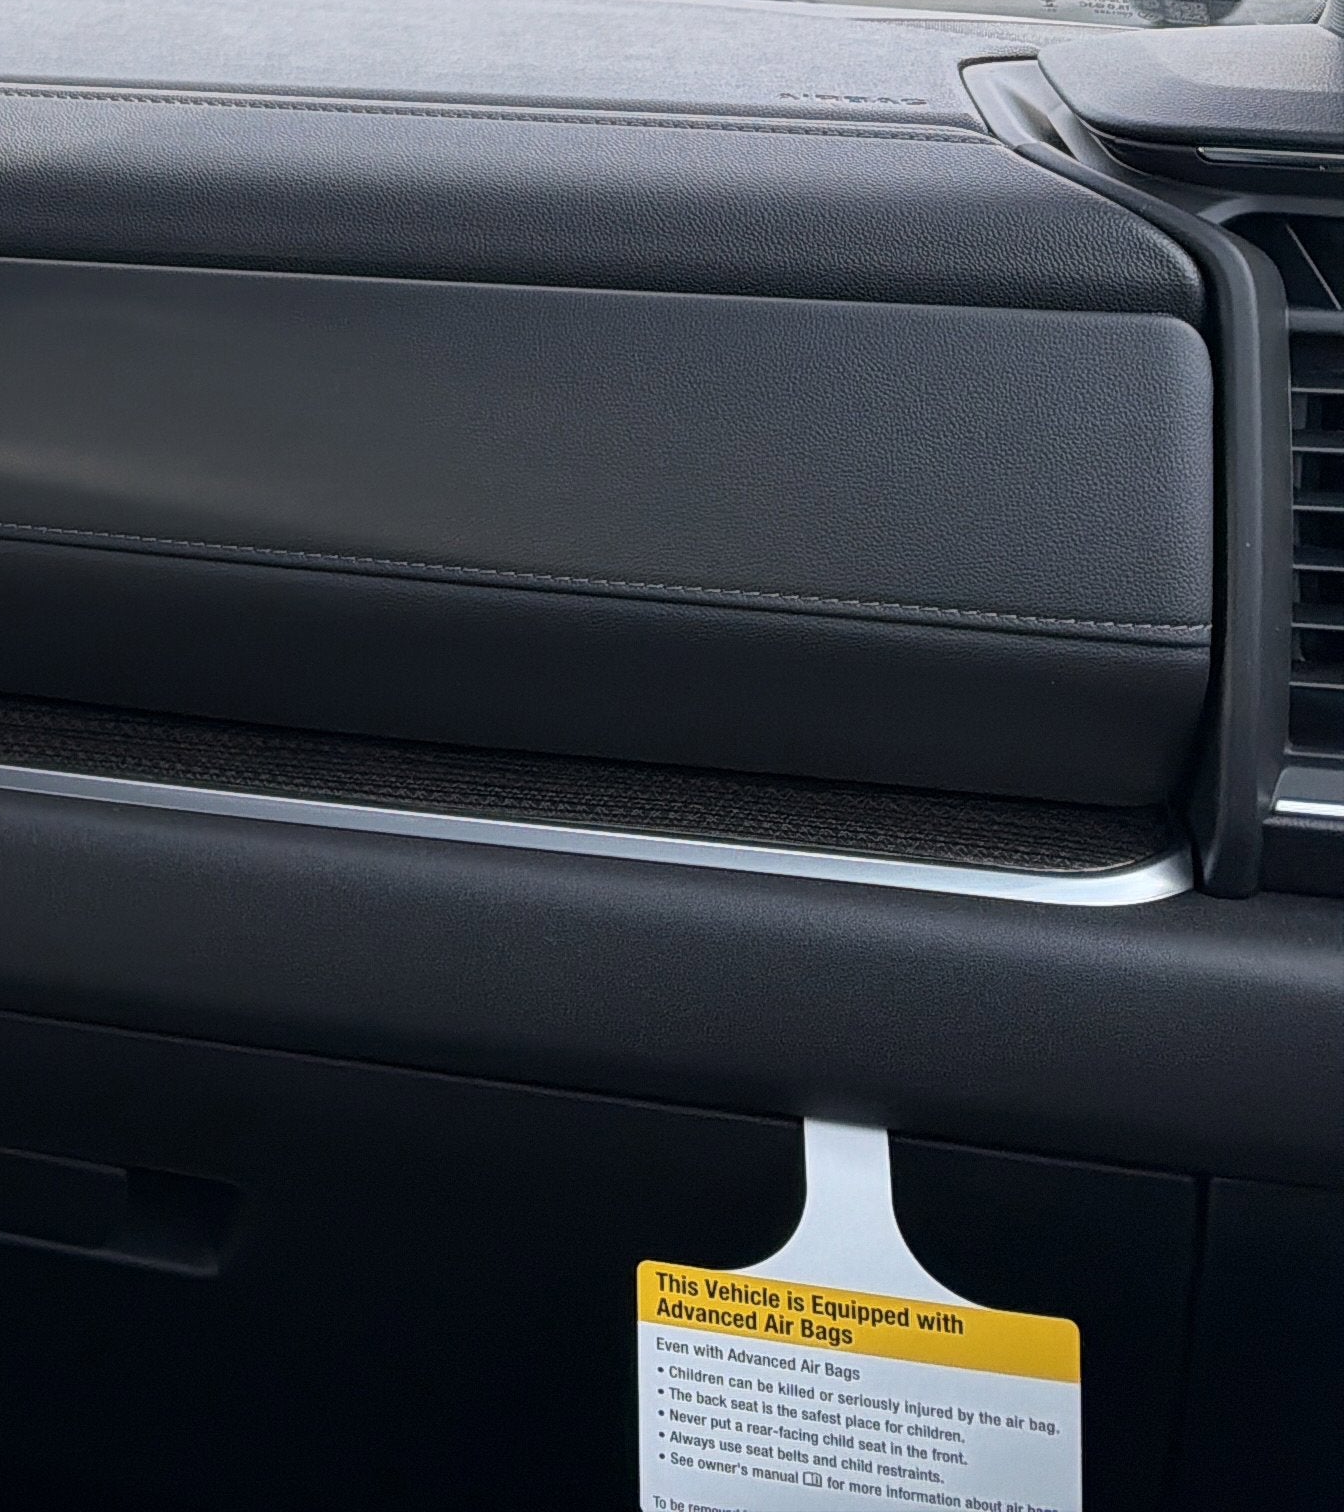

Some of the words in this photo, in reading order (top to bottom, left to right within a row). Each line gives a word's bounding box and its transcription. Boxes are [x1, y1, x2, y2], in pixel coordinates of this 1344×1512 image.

[656, 1272, 699, 1296] This
[704, 1279, 780, 1308] Vehicle
[787, 1291, 804, 1312] is
[812, 1295, 909, 1327] Equipped
[917, 1312, 964, 1335] with
[657, 1298, 757, 1330] Advanced
[764, 1313, 794, 1335] Air
[801, 1319, 853, 1346] Bags
[656, 1337, 689, 1354] Even
[693, 1343, 723, 1360] with
[728, 1348, 796, 1371] Advanced
[800, 1359, 820, 1374] Air
[825, 1363, 860, 1382] Bags
[669, 1365, 724, 1386] Children
[729, 1378, 752, 1391] can
[757, 1379, 773, 1393] be
[778, 1382, 815, 1400] killed
[819, 1392, 834, 1402] or
[838, 1393, 900, 1414] seriously
[904, 1400, 952, 1420] injured
[957, 1408, 974, 1424] by
[979, 1411, 1001, 1427] the
[1005, 1415, 1025, 1430] air
[1029, 1418, 1060, 1436] bag.
[669, 1387, 692, 1402] The
[696, 1391, 727, 1409] back
[731, 1398, 758, 1412] seat
[762, 1400, 773, 1415] is
[777, 1404, 797, 1419] the
[801, 1409, 841, 1426] safest
[845, 1415, 880, 1431] place
[885, 1420, 902, 1434] for
[907, 1423, 965, 1444] children.
[669, 1408, 707, 1426] Never
[711, 1418, 731, 1431] put
[735, 1422, 743, 1432] a
[747, 1423, 819, 1446] rear-facing
[822, 1433, 854, 1449] child
[858, 1439, 886, 1454] seat
[890, 1442, 902, 1456] in
[906, 1445, 927, 1459] the
[932, 1449, 968, 1466] front.
[670, 1431, 715, 1450] Always
[719, 1440, 742, 1453] use
[746, 1444, 773, 1459] seat
[777, 1447, 809, 1464] belts
[812, 1454, 837, 1468] and
[841, 1457, 872, 1473] child
[877, 1463, 945, 1484] restraints.
[653, 1495, 667, 1509] To
[670, 1498, 684, 1512] be
[670, 1452, 694, 1468] See
[698, 1459, 748, 1476] owner's
[752, 1466, 799, 1484] manual
[827, 1476, 845, 1491] for
[849, 1480, 882, 1497] more
[886, 1485, 961, 1508] information
[965, 1497, 1002, 1512] about
